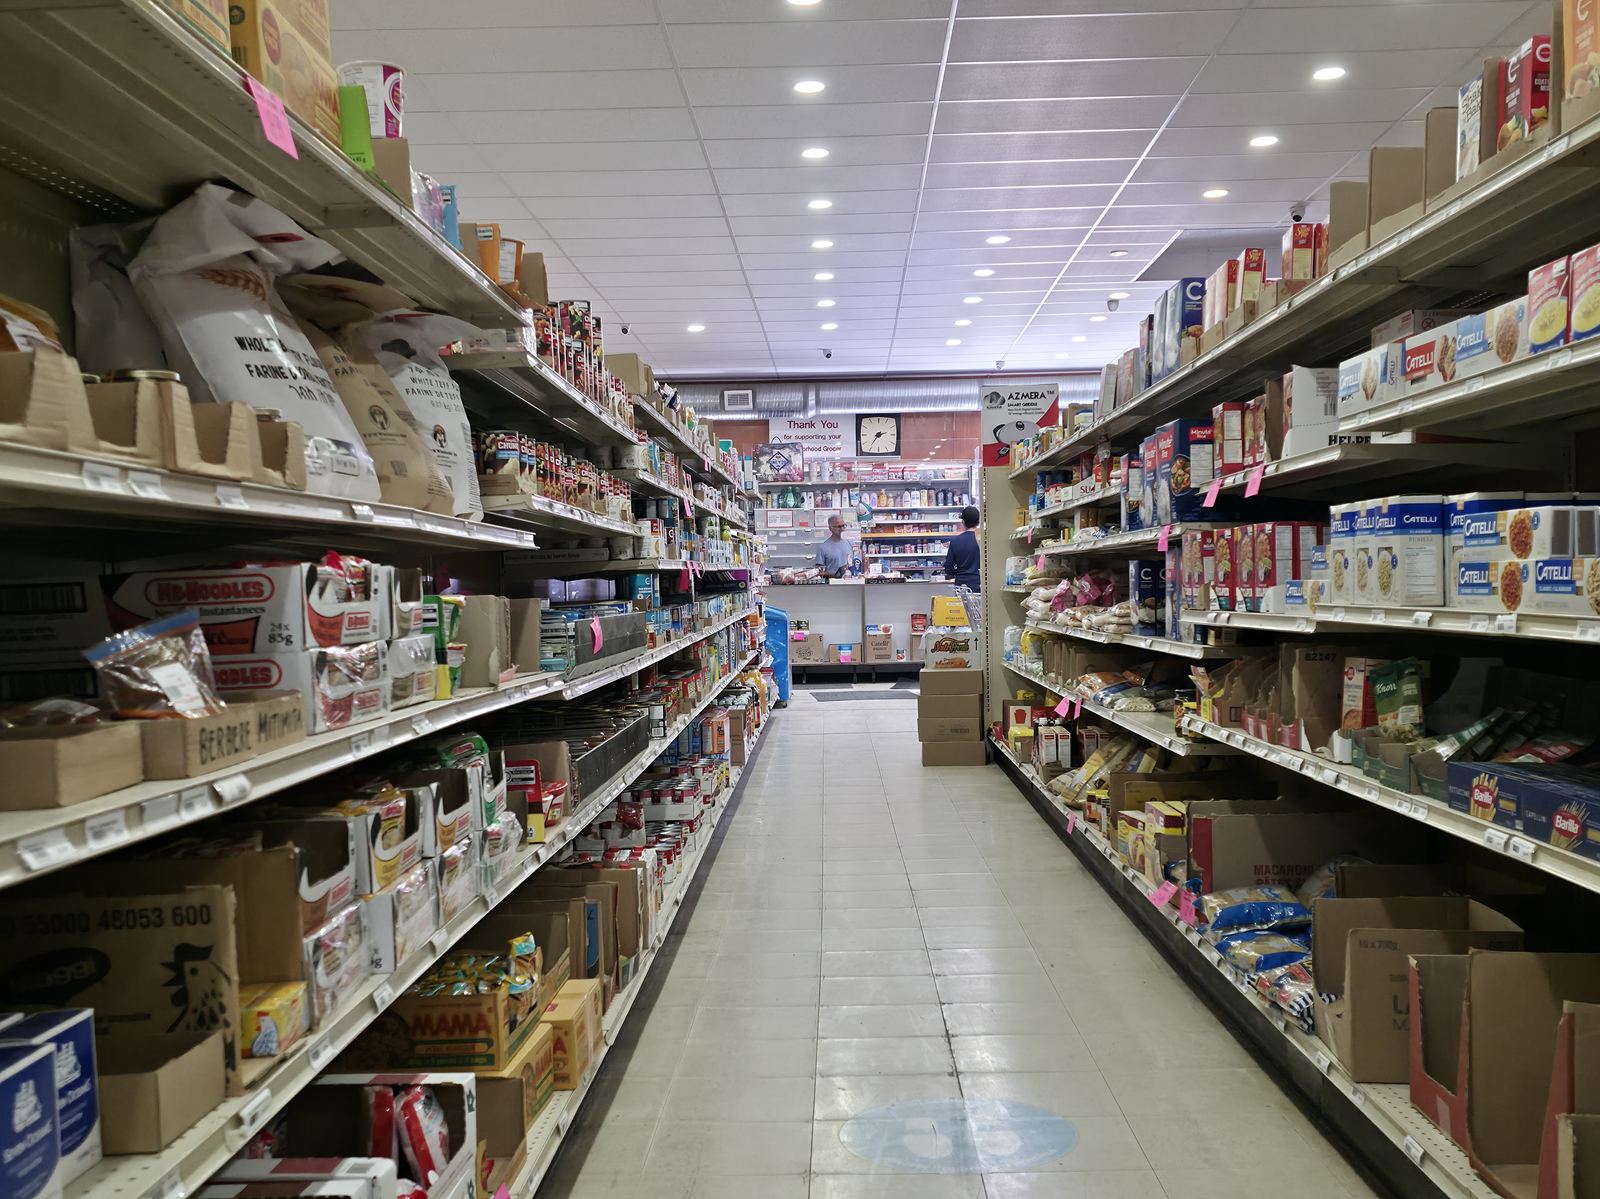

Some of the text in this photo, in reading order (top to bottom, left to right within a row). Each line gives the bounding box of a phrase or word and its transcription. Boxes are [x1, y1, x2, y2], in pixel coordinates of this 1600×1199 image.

[1406, 351, 1434, 372] CATELLI
[245, 364, 289, 379] FARINE
[405, 388, 433, 397] FARINE
[787, 420, 838, 429] Thank You
[795, 434, 826, 442] supporting
[828, 434, 841, 442] your
[1376, 516, 1396, 528] CATELLI
[1404, 515, 1437, 523] CATELLI
[1450, 513, 1464, 526] CATE
[1465, 520, 1496, 536] CATELLI
[1460, 568, 1488, 584] CATELLI
[1537, 562, 1571, 580] CATELLI
[268, 633, 293, 646] 85g
[200, 720, 252, 765] BERBERE
[1474, 788, 1492, 805] Barilla
[1555, 814, 1578, 834] Barilla
[98, 907, 164, 930] 48053
[172, 904, 212, 927] 600
[412, 1014, 492, 1037] MAMA
